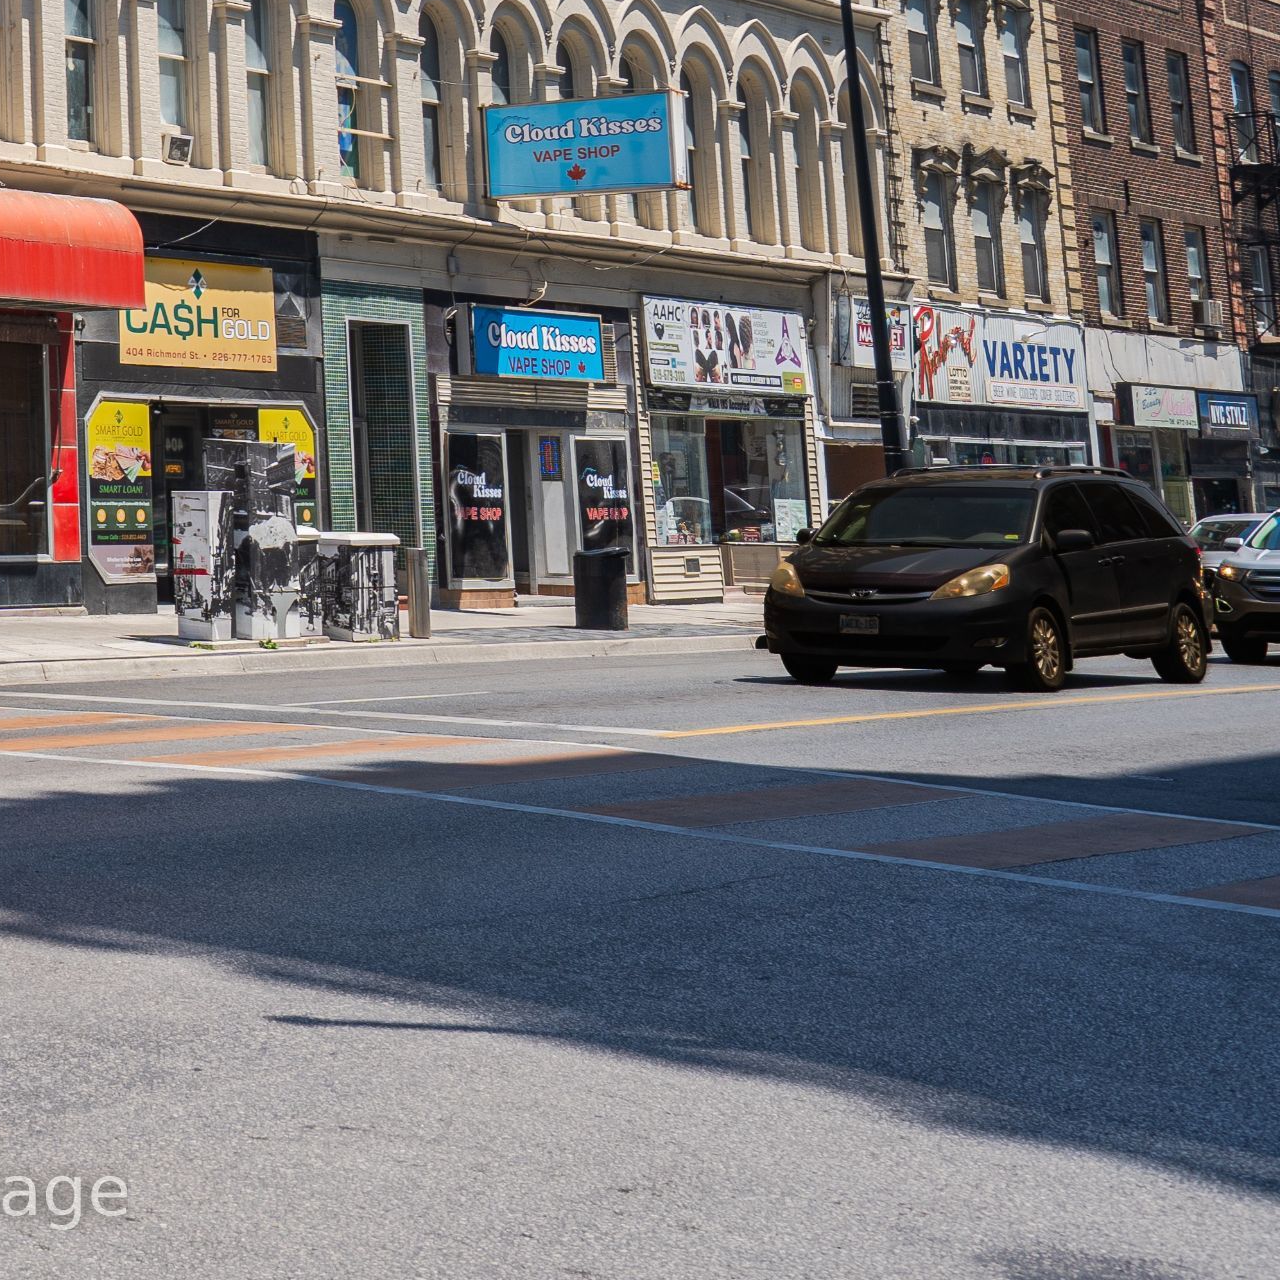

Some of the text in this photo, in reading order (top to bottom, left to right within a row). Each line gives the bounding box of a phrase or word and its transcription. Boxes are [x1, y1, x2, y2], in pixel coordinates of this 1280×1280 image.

[504, 116, 663, 145] Cloud Kisses
[533, 145, 620, 163] VAPE SHOP
[222, 307, 240, 318] FOR
[222, 319, 271, 341] GOLD
[858, 326, 903, 346] MAET
[487, 321, 597, 354] Cloud Kisses
[126, 348, 272, 364] 404 Richmond St. 226-777-1763
[983, 339, 1076, 384] VARIETY
[508, 356, 571, 376] VAPE SHOP
[949, 367, 967, 378] LOTTO
[1210, 405, 1248, 426] NYC STYLZ
[95, 425, 143, 436] SMART GOLD
[266, 431, 307, 441] SMART GOLD
[457, 471, 486, 486] Cloud
[585, 473, 613, 487] Cloud
[99, 485, 143, 494] SMART LOAN!
[473, 485, 502, 499] Kisses
[603, 486, 627, 499] Kisses
[480, 508, 502, 520] SHOP
[586, 507, 629, 520] VAPE SHOP
